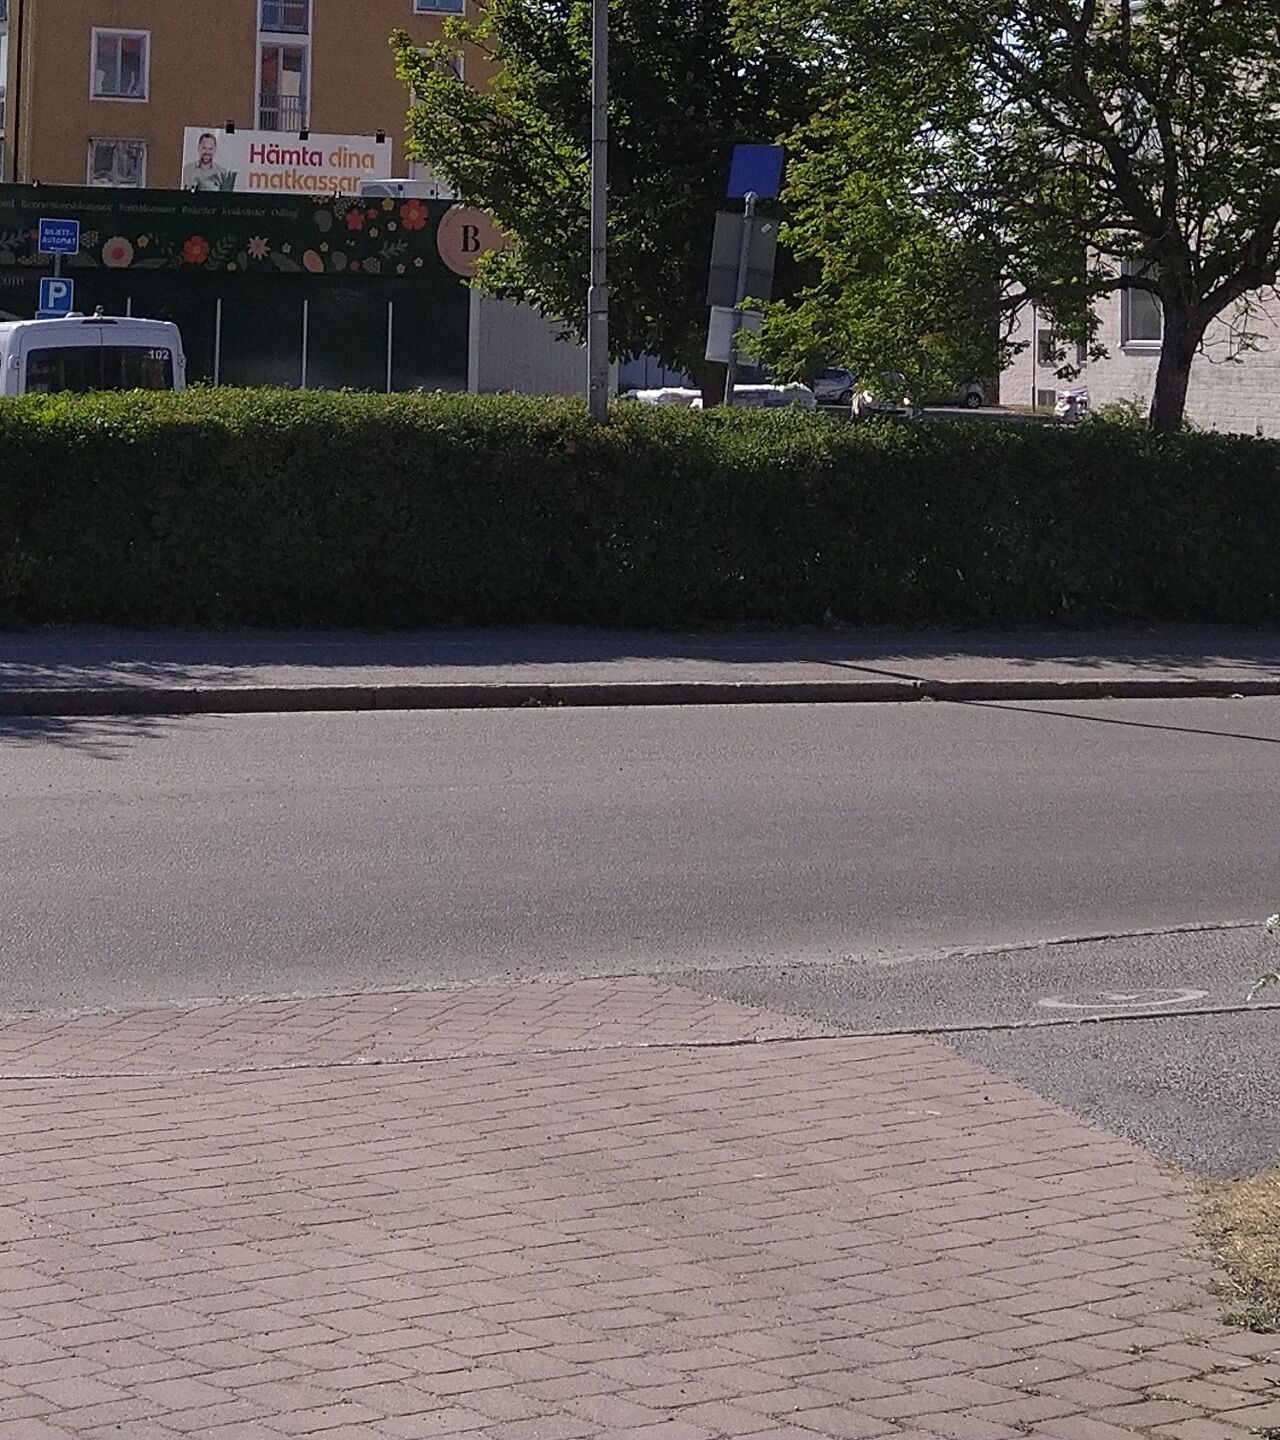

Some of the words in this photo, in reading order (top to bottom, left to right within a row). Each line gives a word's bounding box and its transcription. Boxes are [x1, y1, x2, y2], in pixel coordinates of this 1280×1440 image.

[249, 143, 323, 167] Hämta
[328, 146, 375, 169] dina
[249, 169, 361, 192] matkassar
[42, 236, 75, 245] AUTOMAT
[461, 225, 480, 252] B
[48, 281, 67, 308] P
[148, 349, 169, 360] 102
